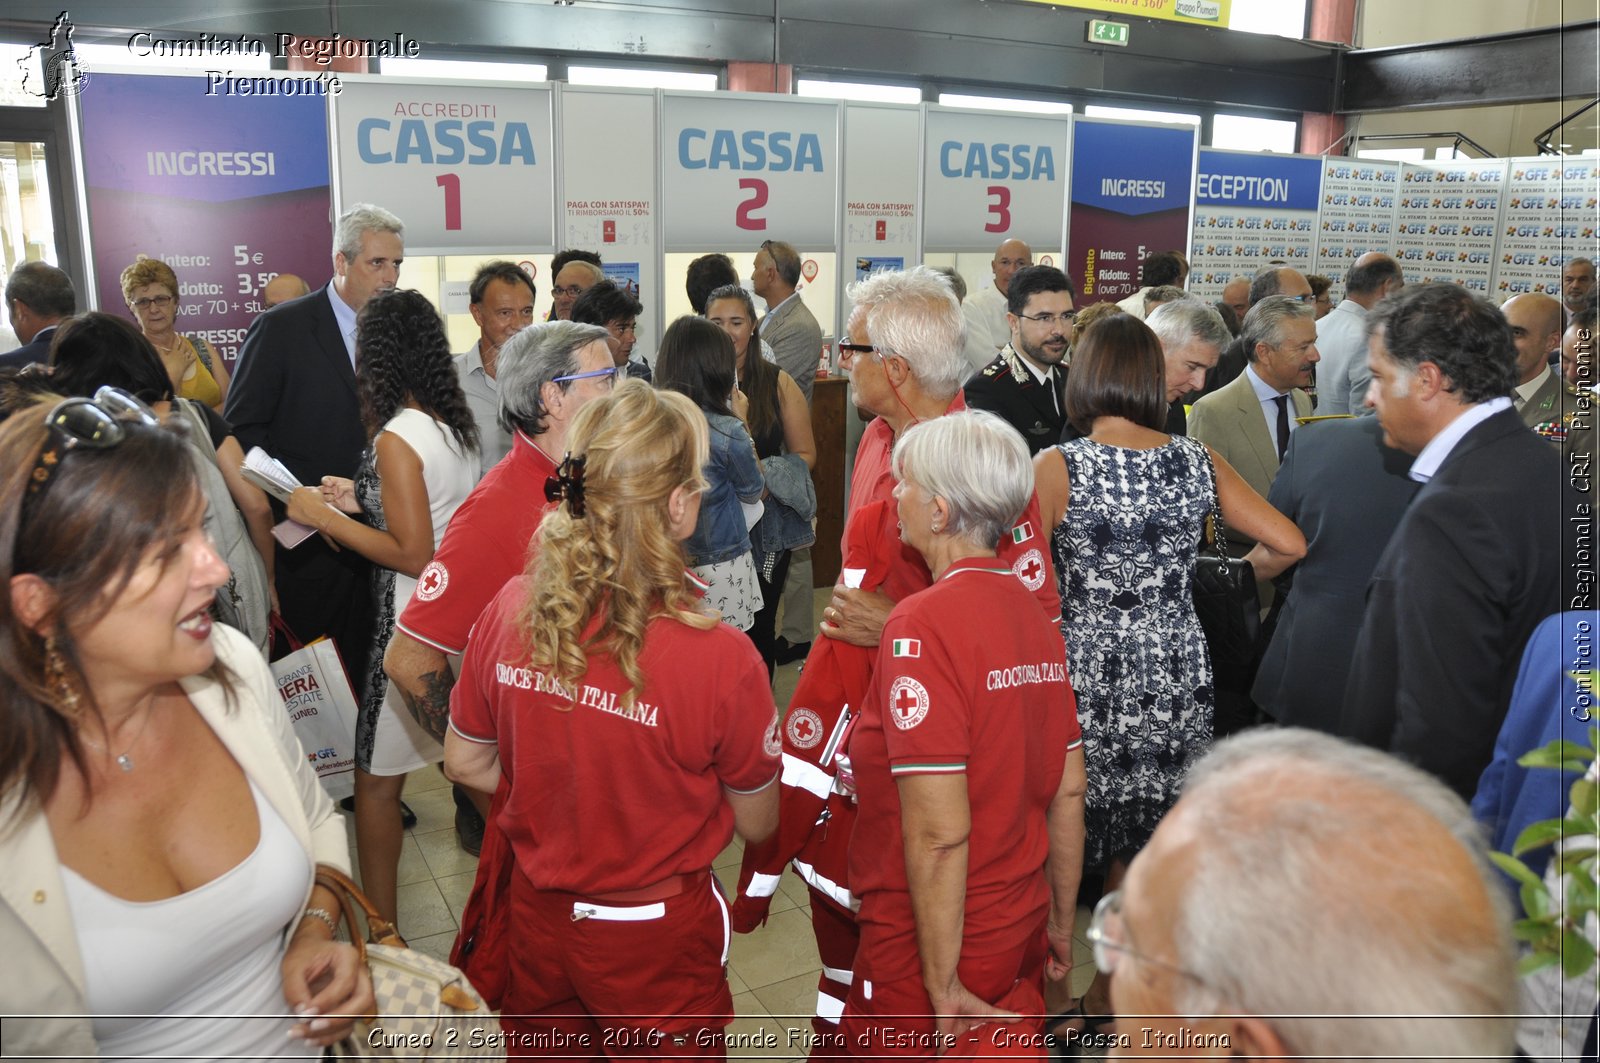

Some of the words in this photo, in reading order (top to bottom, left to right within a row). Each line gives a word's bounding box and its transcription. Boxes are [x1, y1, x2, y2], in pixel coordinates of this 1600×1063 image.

[394, 102, 497, 118] ACCREDITI
[357, 117, 536, 166] CASSA
[678, 128, 824, 172] CASSA
[147, 150, 275, 176] INGRESSI
[940, 140, 1056, 181] CASSA
[1336, 166, 1350, 179] GFE
[1360, 168, 1373, 180] GFE
[1383, 170, 1396, 182] GFE
[1414, 170, 1434, 182] GFE
[1446, 170, 1466, 182] GFE
[1480, 170, 1501, 182] GFE
[1525, 167, 1549, 181] GFE
[1564, 166, 1588, 180] GFE
[1102, 178, 1166, 198] INGRESSI
[1197, 174, 1288, 202] ECEPTION
[436, 173, 462, 230] 1
[735, 178, 769, 231] 2
[1333, 193, 1348, 206] GFE
[1357, 195, 1372, 207] GFE
[1380, 196, 1393, 208] GFE
[1410, 196, 1429, 208] GFE
[1442, 197, 1462, 209] GFE
[1476, 196, 1497, 209] GFE
[1521, 196, 1544, 209] GFE
[1559, 196, 1583, 209] GFE
[984, 185, 1011, 233] 3
[1217, 216, 1234, 228] GFE
[1245, 217, 1261, 230] GFE
[1272, 218, 1288, 230] GFE
[1297, 219, 1312, 231] GFE
[1330, 220, 1345, 232] GFE
[1355, 222, 1369, 232] GFE
[1377, 223, 1390, 233] GFE
[1407, 222, 1427, 235] GFE
[1438, 224, 1459, 236] GFE
[1472, 224, 1494, 237] GFE
[1517, 224, 1540, 237] GFE
[1554, 225, 1577, 238] GFE
[1100, 249, 1126, 260] Intero:
[1216, 244, 1232, 256] GFE
[1244, 245, 1259, 257] GFE
[1270, 246, 1285, 257] GFE
[1294, 246, 1309, 258] GFE
[1404, 248, 1424, 260] GFE
[1435, 250, 1455, 262] GFE
[1468, 251, 1490, 264] GFE
[1513, 252, 1536, 265] GFE
[1084, 249, 1095, 294] Biglietto
[1099, 269, 1130, 280] Ridotto:
[1098, 284, 1118, 295] (over
[1120, 284, 1132, 294] 70
[1509, 280, 1531, 293] GFE
[206, 300, 228, 314] 70
[277, 663, 314, 686] GRANDE
[317, 748, 337, 759] GFE
